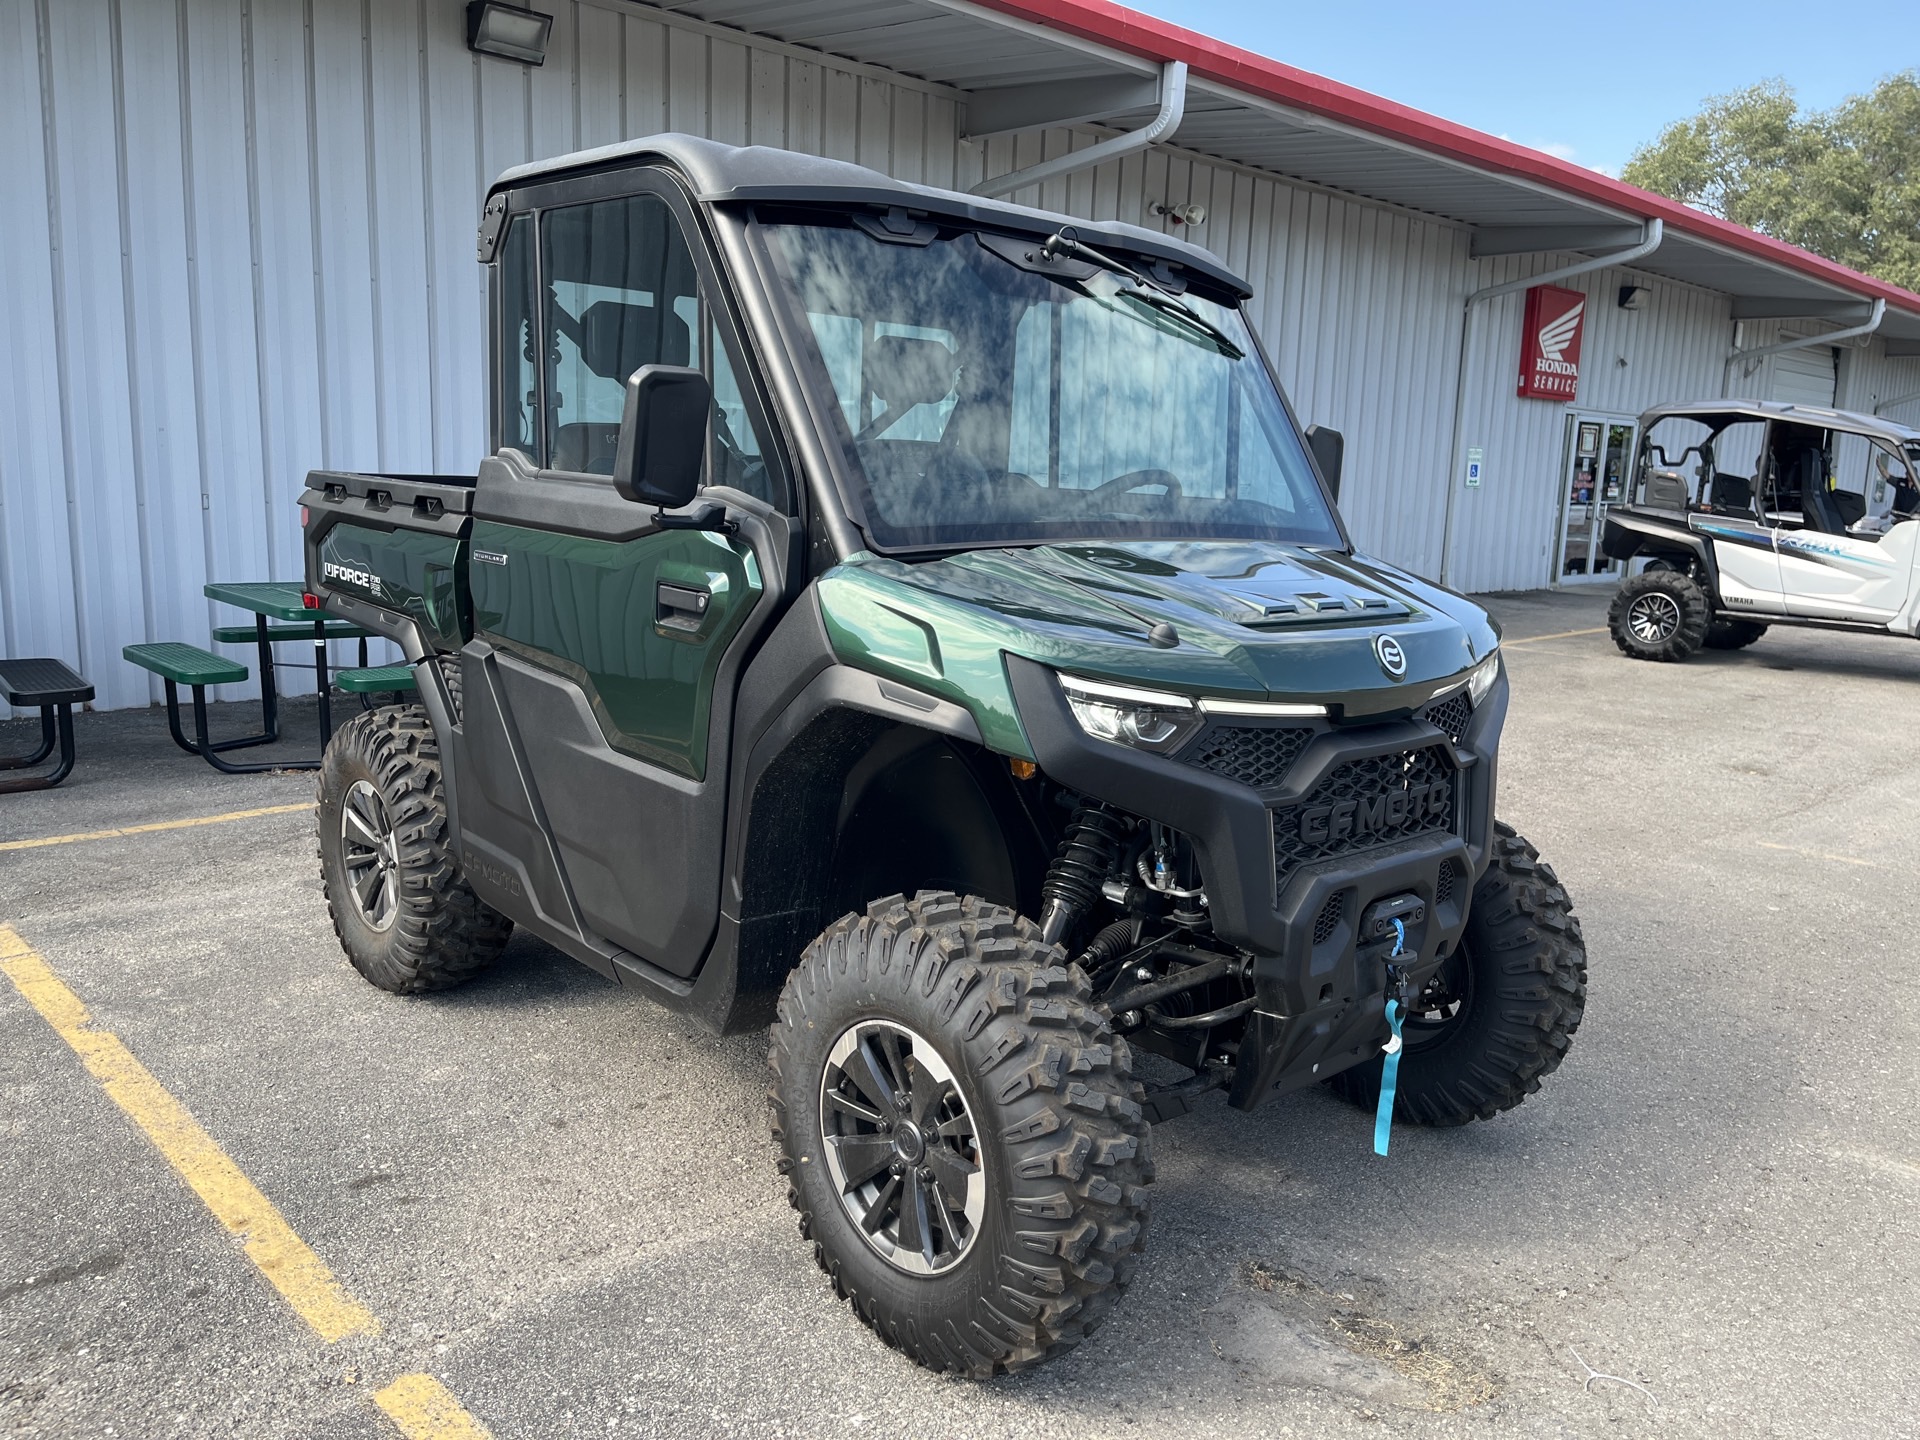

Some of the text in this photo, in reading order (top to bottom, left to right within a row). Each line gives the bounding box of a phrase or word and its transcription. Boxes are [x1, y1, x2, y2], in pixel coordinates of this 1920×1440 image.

[1536, 358, 1578, 376] HONDA
[1534, 374, 1577, 393] SERVICE
[324, 562, 370, 588] UFORCE
[1724, 596, 1754, 606] YAMAHA
[1301, 780, 1448, 844] CFMOTO
[464, 851, 521, 897] CFMOTO
